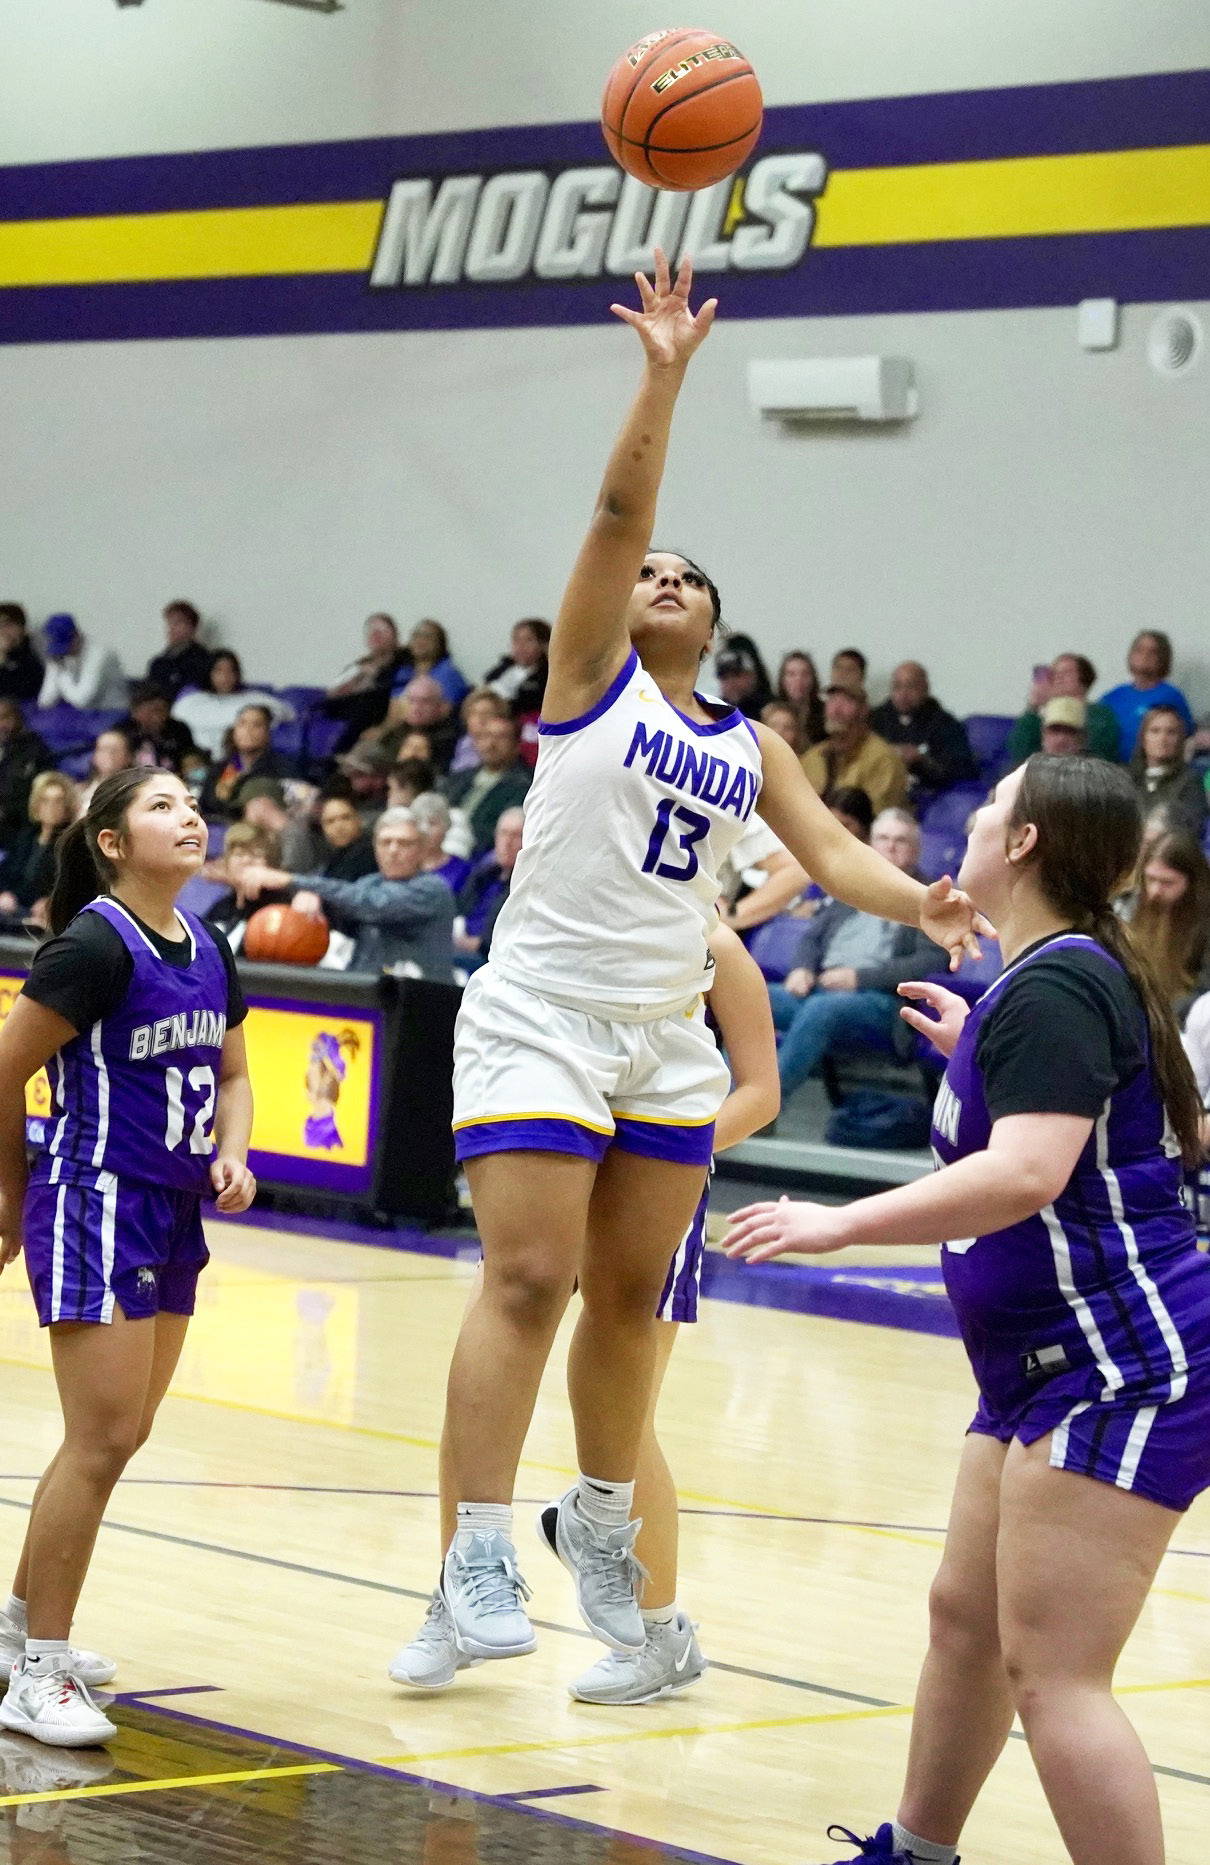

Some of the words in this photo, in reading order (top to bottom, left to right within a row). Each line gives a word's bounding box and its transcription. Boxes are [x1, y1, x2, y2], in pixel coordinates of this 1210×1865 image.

[369, 152, 826, 287] MOGULS
[623, 720, 758, 823] MUNDAY
[641, 798, 710, 882] 13
[164, 1065, 215, 1155] 12
